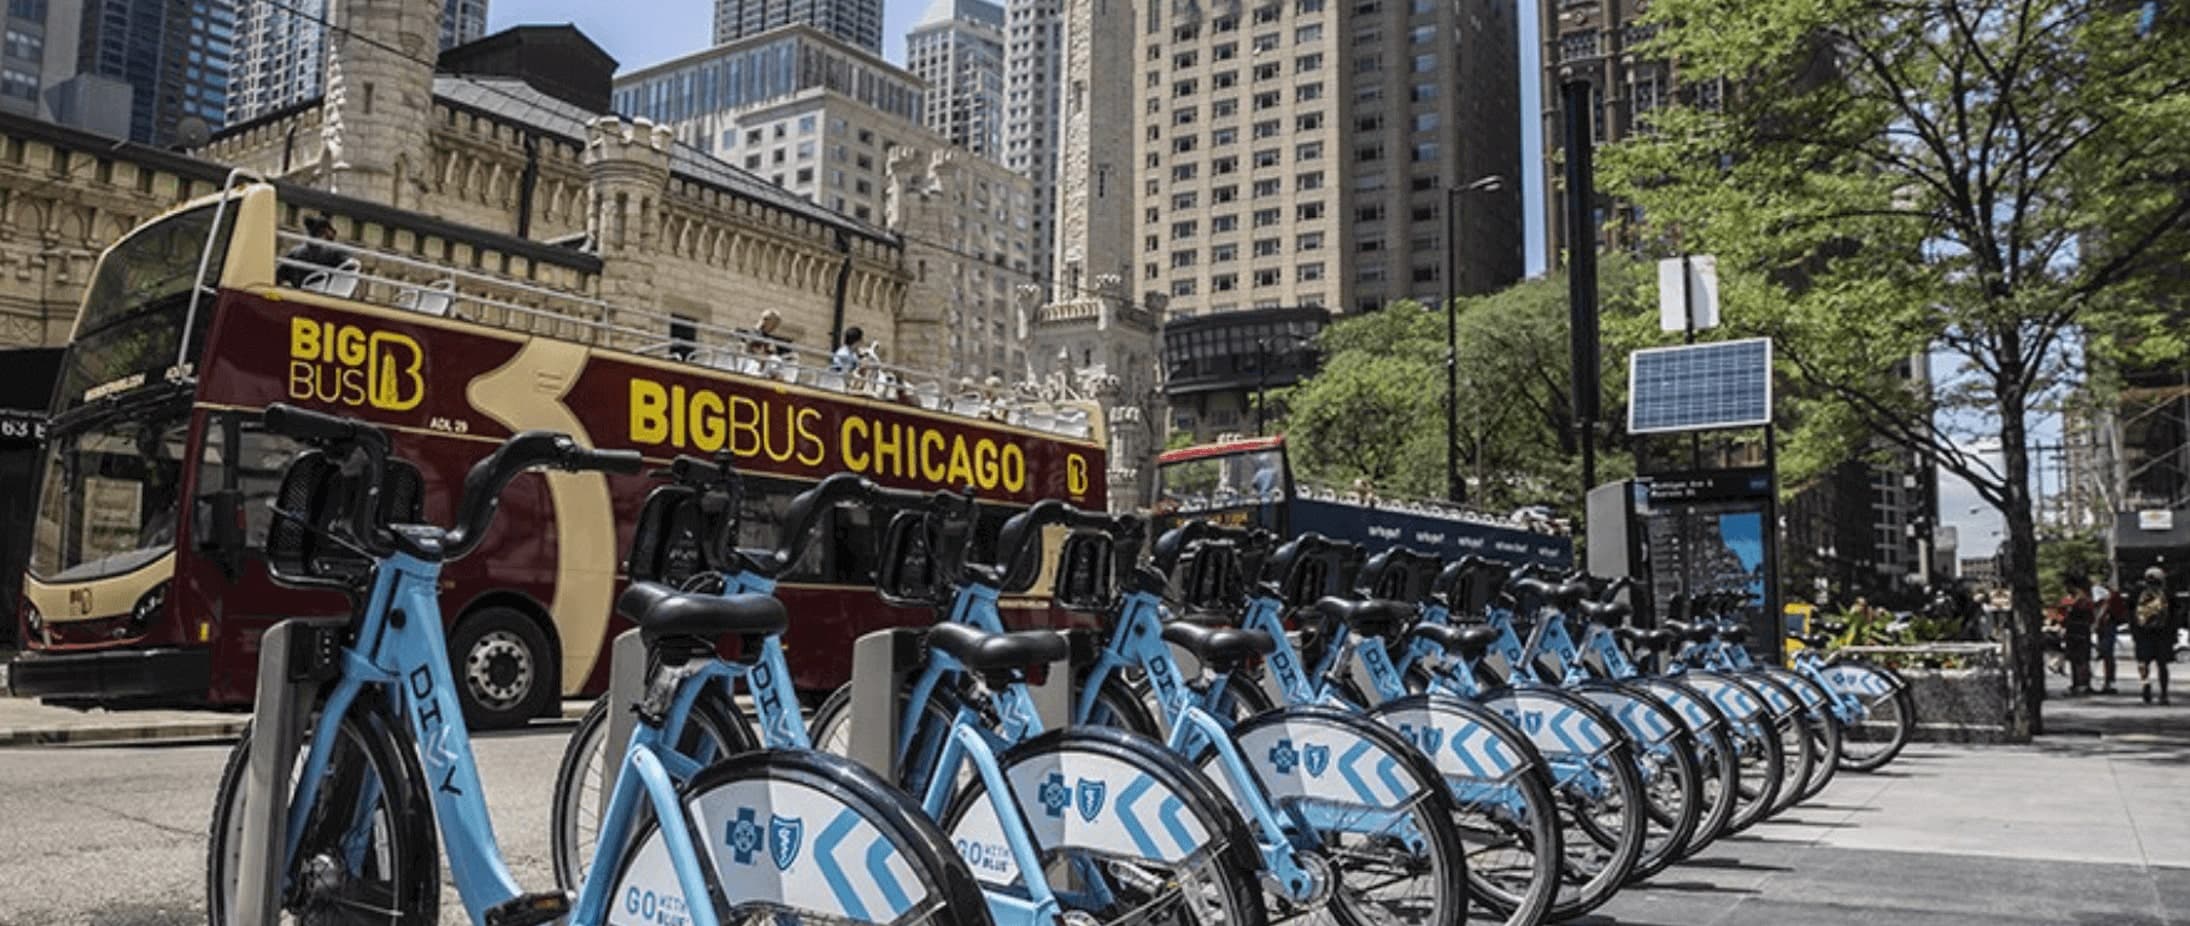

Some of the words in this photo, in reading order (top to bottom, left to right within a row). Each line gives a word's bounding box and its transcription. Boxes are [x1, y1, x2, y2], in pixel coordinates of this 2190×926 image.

[291, 316, 367, 366] BIG
[289, 360, 366, 406] BUS
[841, 417, 1026, 493] CHICAGO
[626, 885, 656, 920] GO
